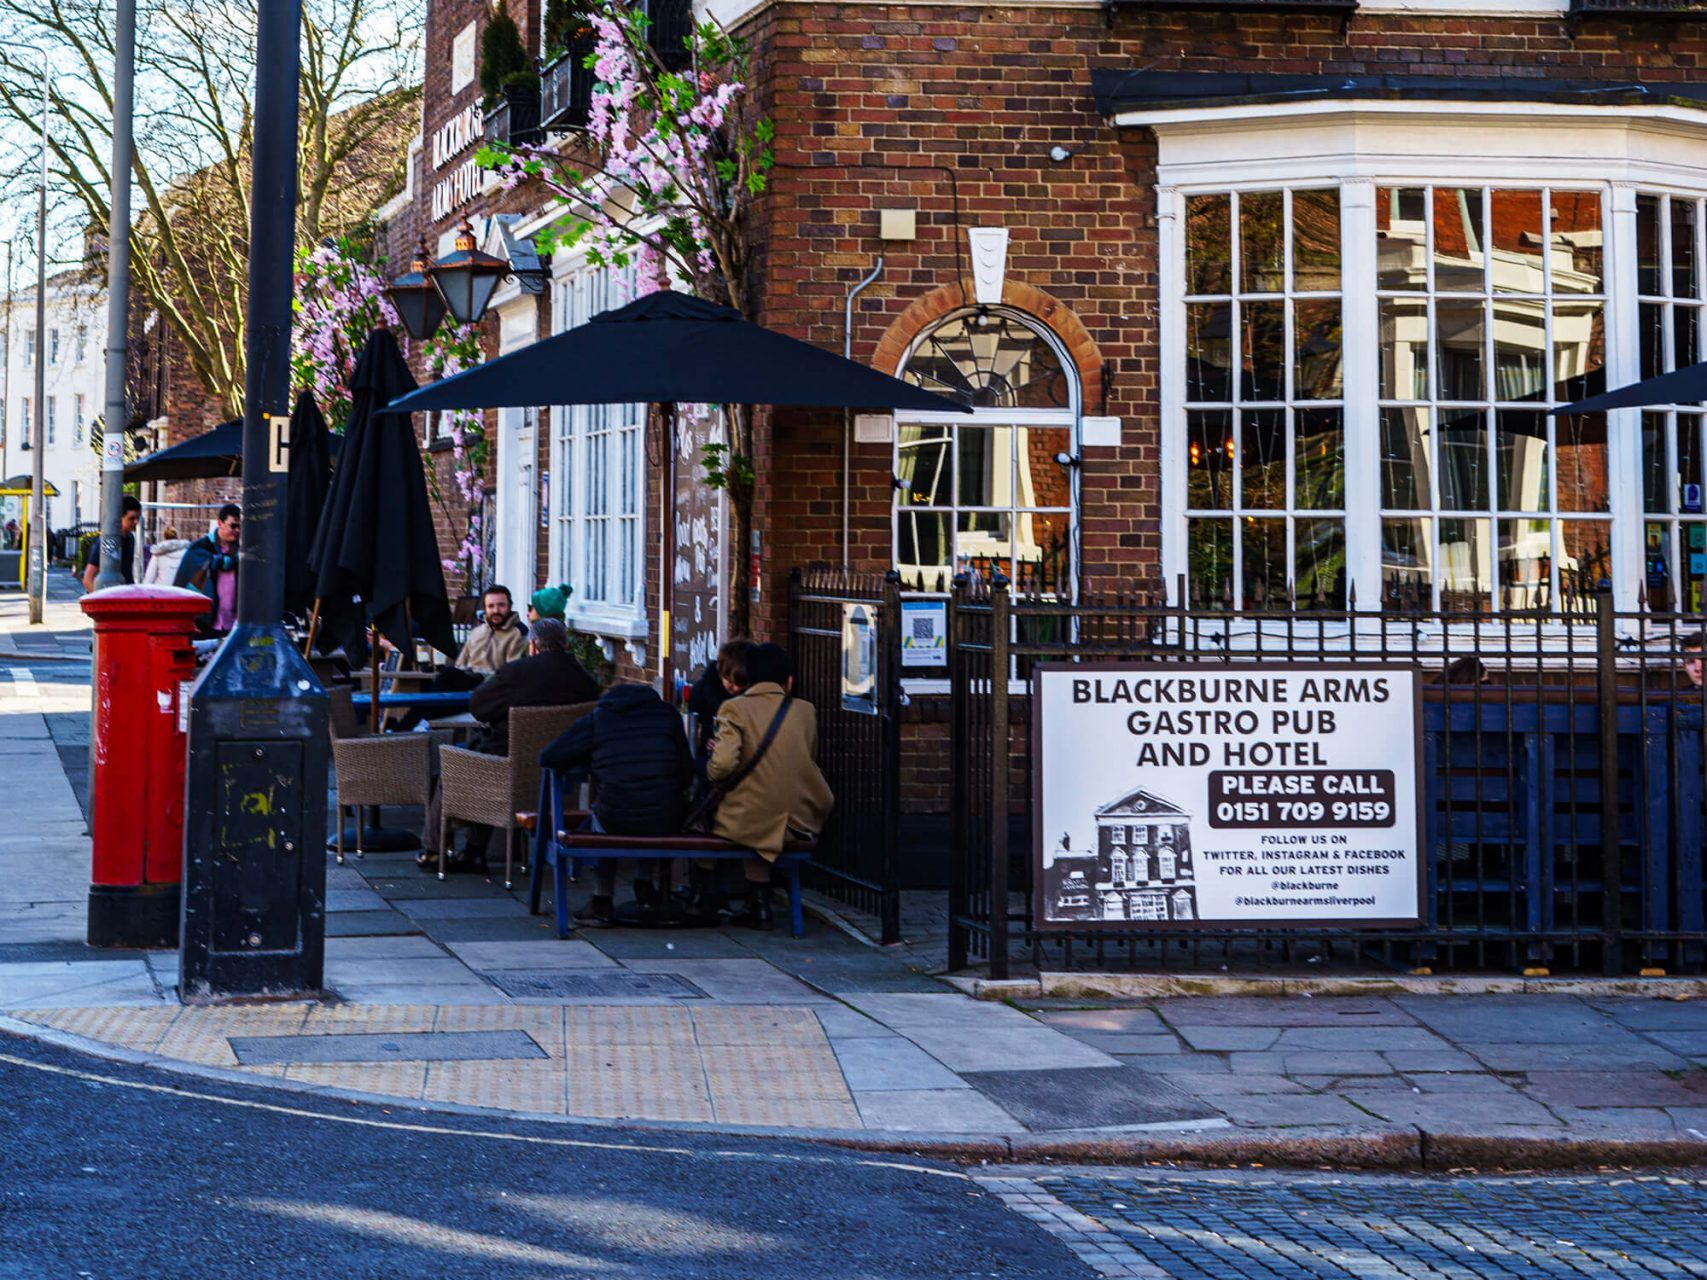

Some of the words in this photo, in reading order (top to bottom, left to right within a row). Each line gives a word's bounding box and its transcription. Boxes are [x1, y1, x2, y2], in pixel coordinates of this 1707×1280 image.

[1072, 678, 1288, 704] BLACKBURNE
[1299, 678, 1390, 703] ARMS
[1126, 710, 1259, 735] GASTRO
[1272, 710, 1337, 735] PUB
[1136, 742, 1210, 767] AND
[1223, 741, 1328, 767] HOTEL
[1221, 775, 1316, 795] PLEASE
[1322, 775, 1385, 794] CALL
[1216, 801, 1270, 821] 0151
[1276, 801, 1325, 821] 709
[1331, 801, 1391, 821] 9159
[1261, 835, 1308, 845] FOLLOW
[1312, 835, 1327, 844] US
[1331, 835, 1347, 844] ON
[1203, 851, 1258, 861] TWITTER,
[1262, 851, 1329, 860] INSTAGRAM
[1333, 850, 1341, 860] &
[1344, 850, 1406, 860] FACEBOOK
[1219, 866, 1243, 876] FOR
[1246, 866, 1269, 876] ALL
[1272, 866, 1296, 875] OUR
[1300, 866, 1343, 875] LATEST
[1349, 865, 1390, 875] DISHES
[1271, 881, 1339, 891] @blackburne
[1234, 896, 1376, 907] @blackburnearmsliverpool
